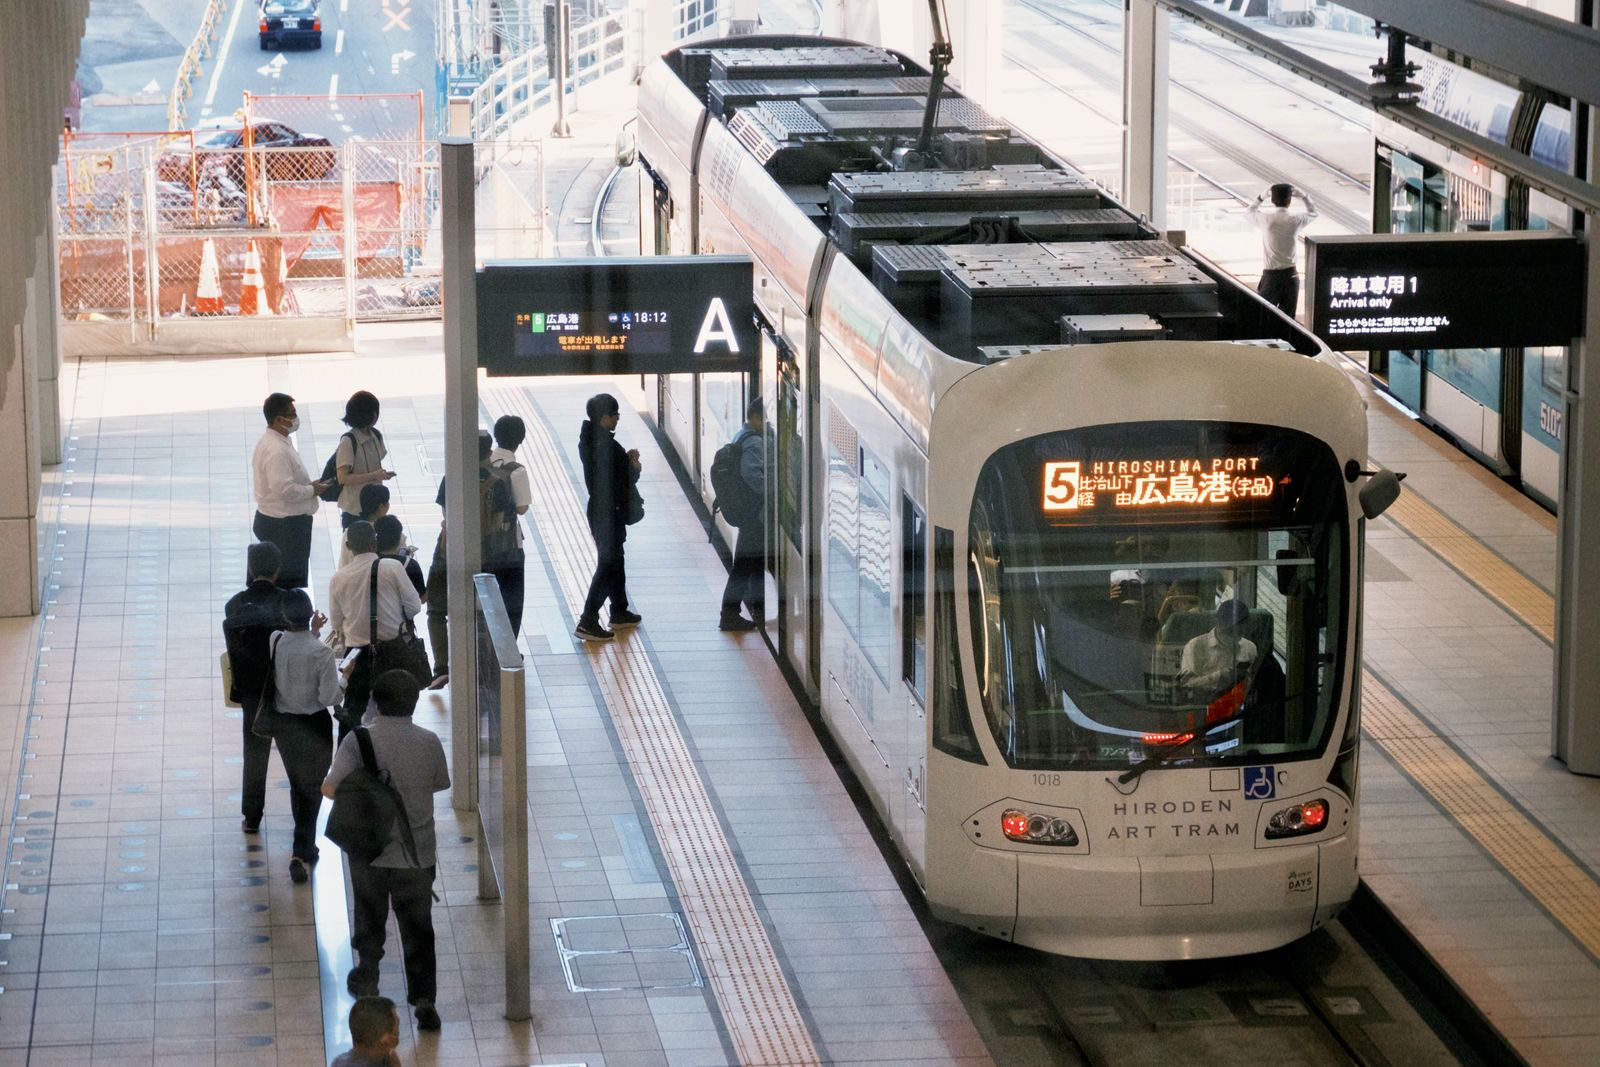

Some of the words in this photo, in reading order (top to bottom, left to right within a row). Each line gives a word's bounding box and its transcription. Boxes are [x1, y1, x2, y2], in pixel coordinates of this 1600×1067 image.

[1330, 275, 1405, 296] 降車専用
[1410, 276, 1417, 294] 1
[1330, 297, 1367, 308] Arrival
[1369, 296, 1393, 310] only
[546, 313, 579, 324] 広島港
[634, 311, 667, 323] 18:12
[693, 298, 740, 354] A
[558, 335, 628, 345] 電車が出発します
[1093, 459, 1201, 475] HIROSHIMA
[1212, 457, 1260, 472] PORT
[1046, 466, 1077, 506] 5
[1079, 475, 1134, 491] 比治山下
[1032, 773, 1061, 786] 1018
[1113, 799, 1232, 816] HIRODEN
[1107, 825, 1156, 840] ART
[1171, 823, 1240, 838] TRAM
[1288, 876, 1313, 890] DAYS
